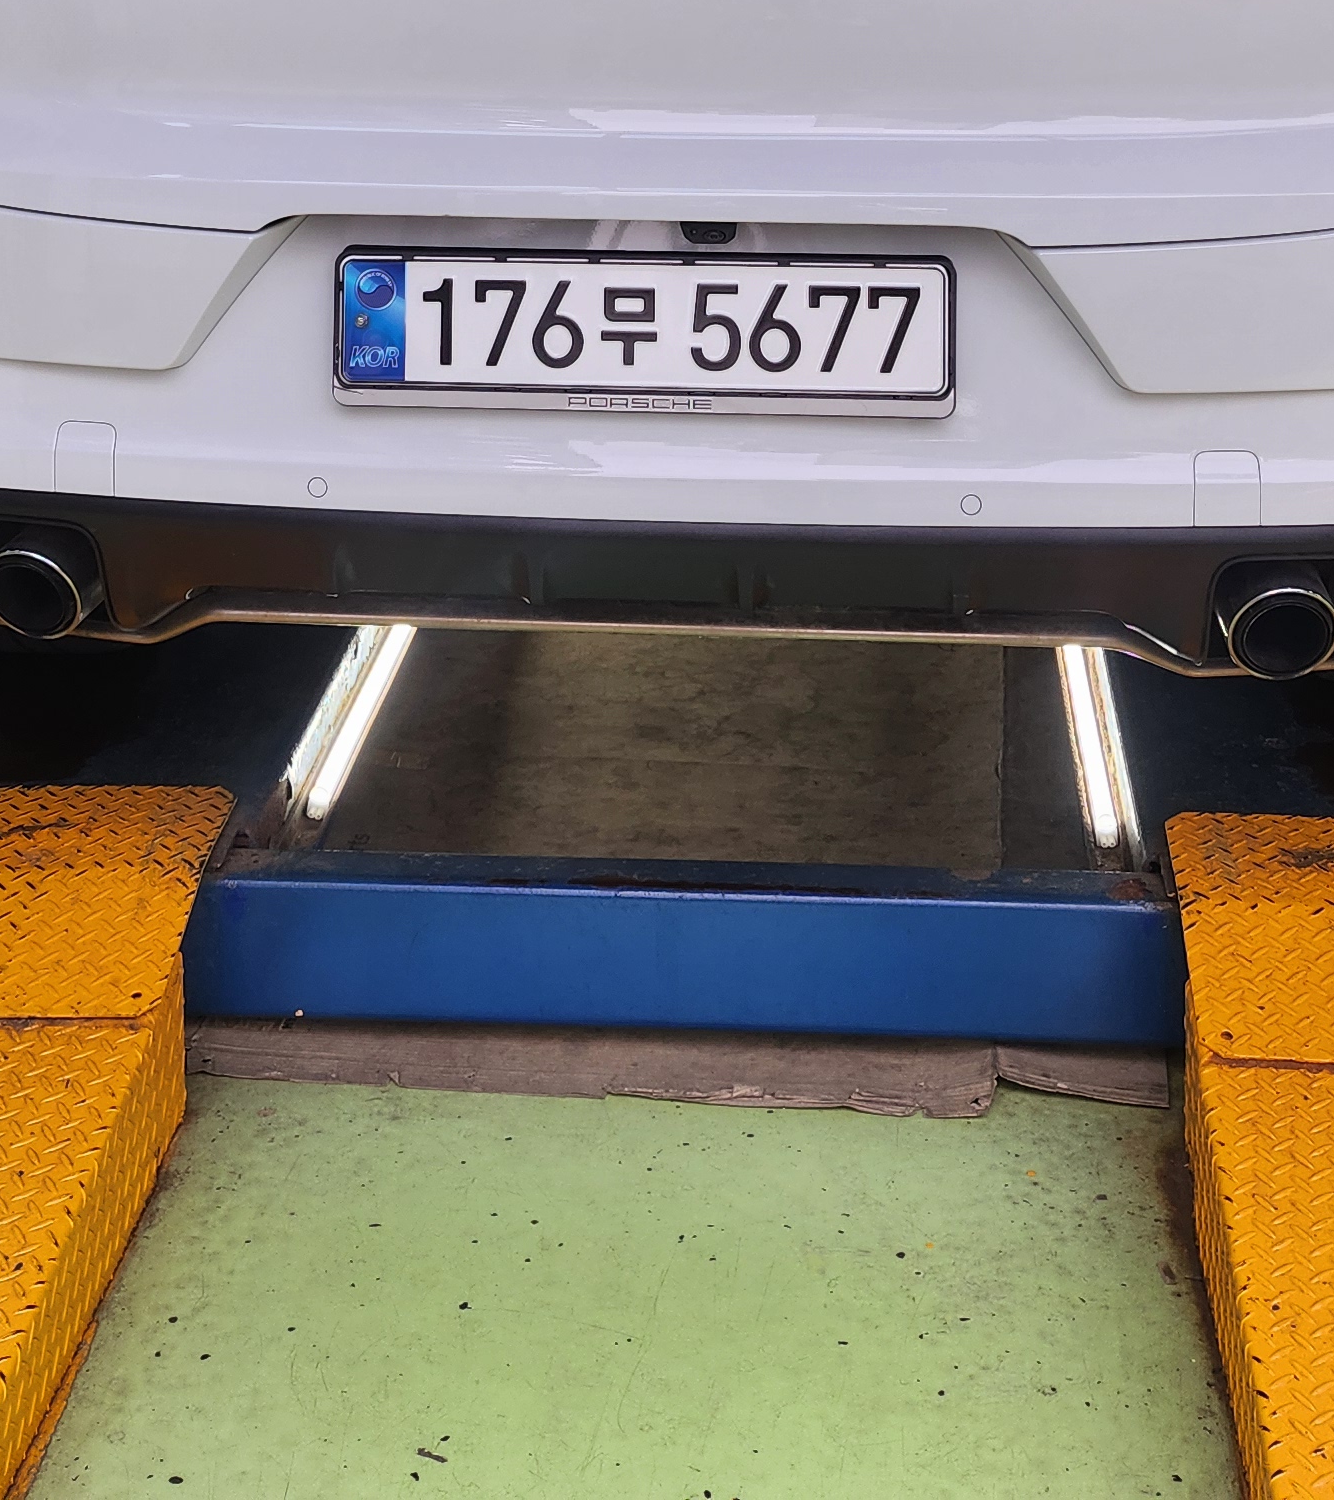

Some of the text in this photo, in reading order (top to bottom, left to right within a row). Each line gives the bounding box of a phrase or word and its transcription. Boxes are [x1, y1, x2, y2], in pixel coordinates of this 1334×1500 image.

[422, 278, 922, 374] 176무 5677
[349, 345, 400, 368] KOR
[567, 396, 713, 411] PORSCHE
